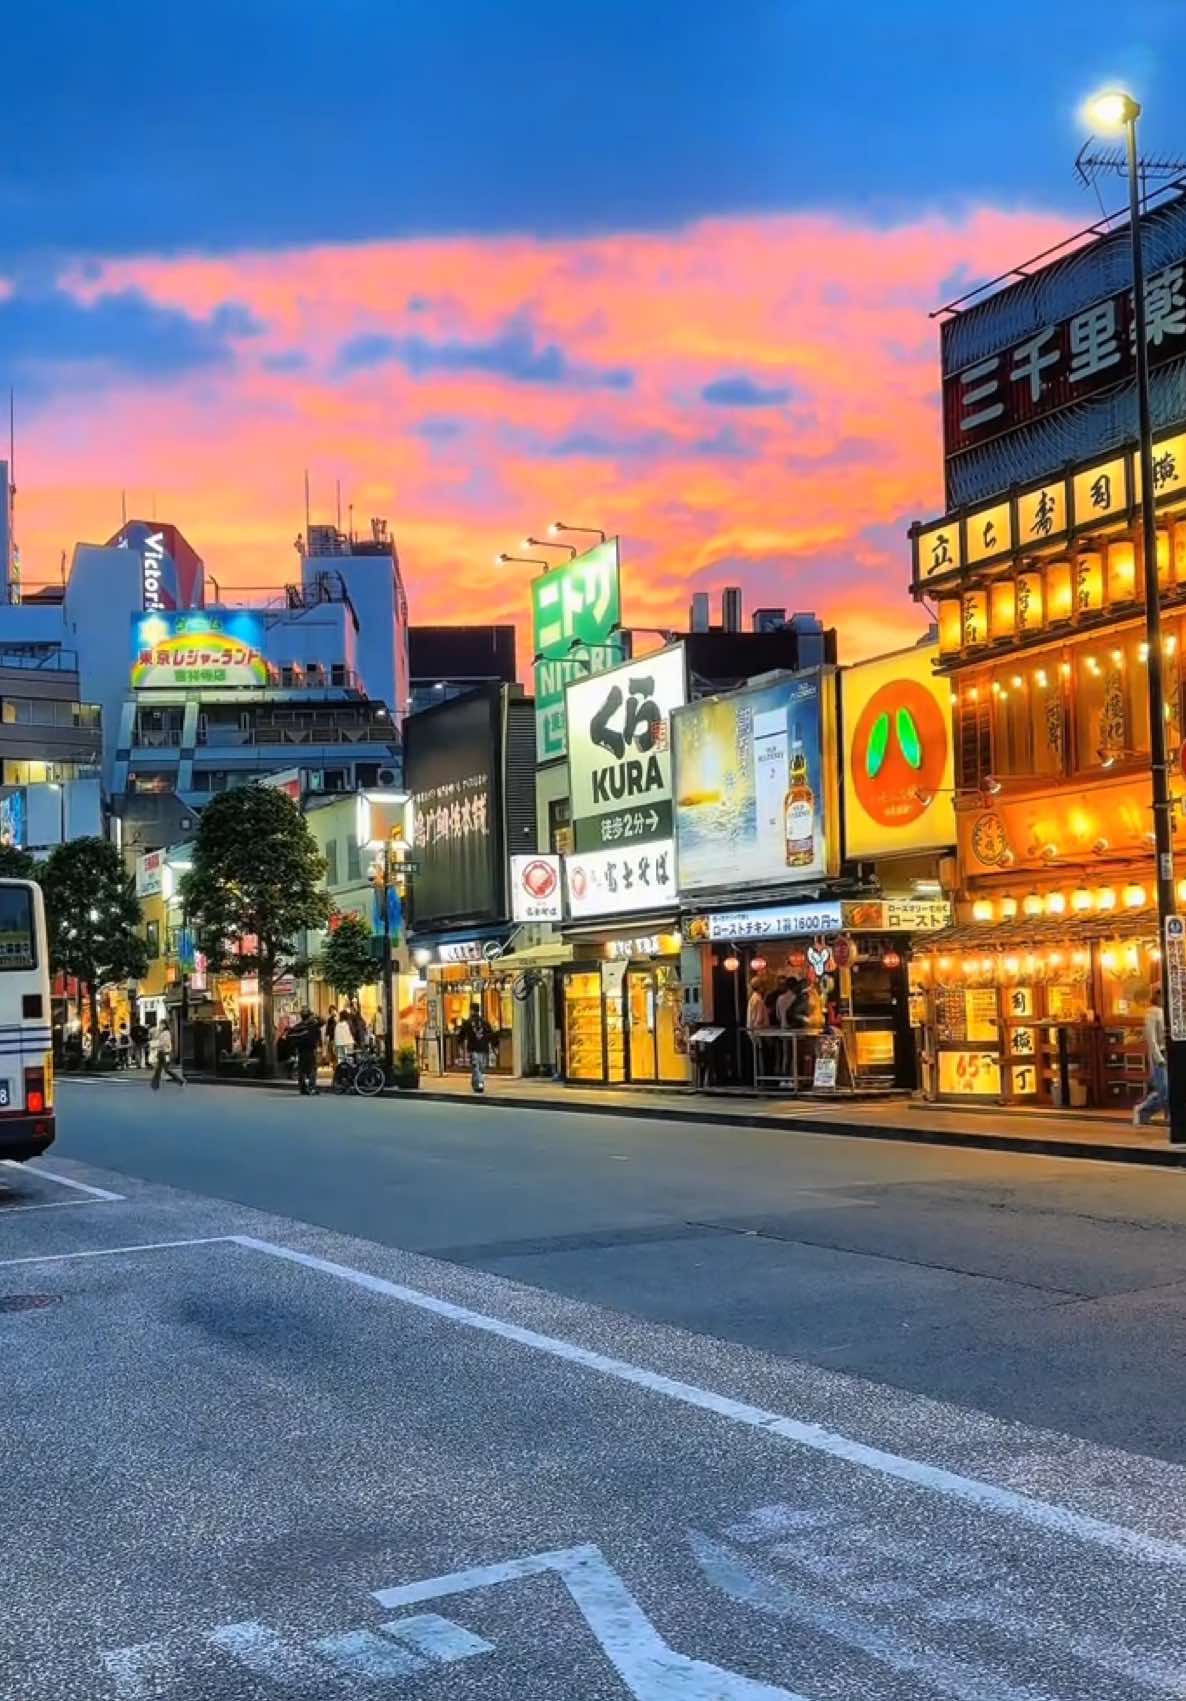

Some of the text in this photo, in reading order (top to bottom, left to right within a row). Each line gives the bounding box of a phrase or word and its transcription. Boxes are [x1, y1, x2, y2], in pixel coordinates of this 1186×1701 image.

[144, 532, 165, 613] Victori
[539, 560, 613, 649] ニトリ
[590, 675, 662, 760] くら
[592, 755, 664, 804] KURA
[601, 812, 645, 841] 徒歩2分
[713, 920, 772, 937] ローストチキン
